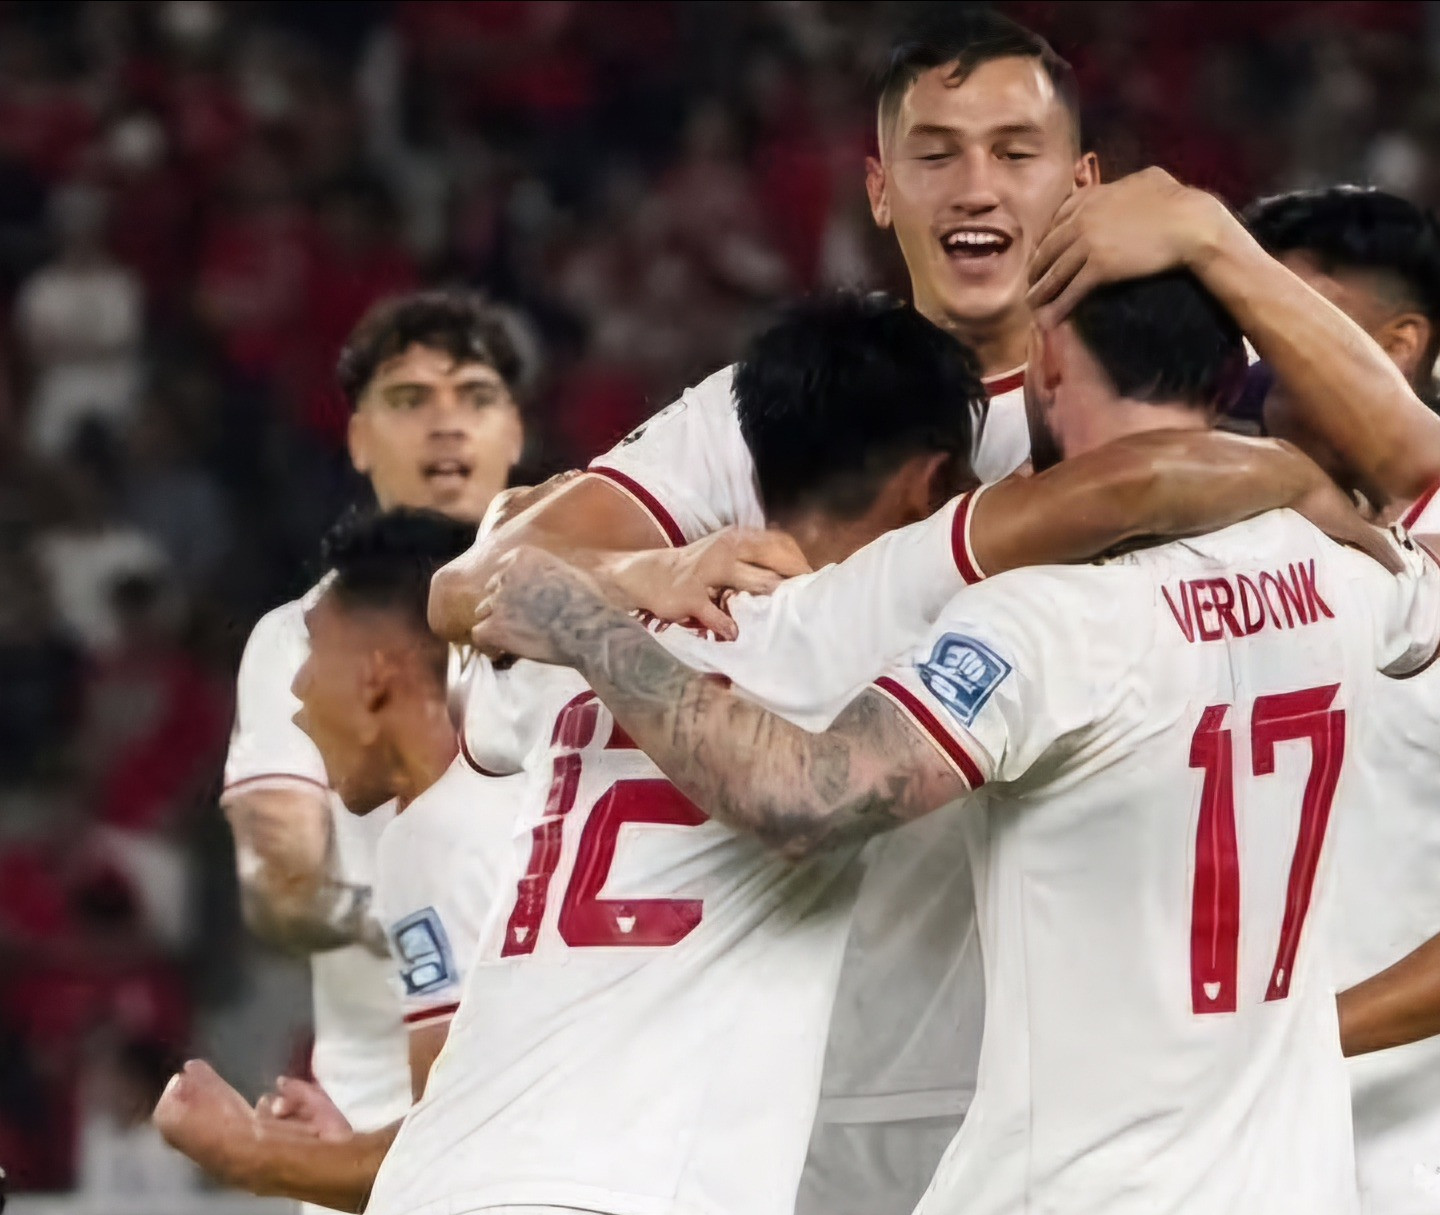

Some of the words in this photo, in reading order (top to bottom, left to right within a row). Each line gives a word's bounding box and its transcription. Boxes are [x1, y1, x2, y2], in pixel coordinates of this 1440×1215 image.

[1161, 558, 1335, 643] VERDONK
[500, 689, 711, 958] 12
[1189, 682, 1346, 1015] 17
